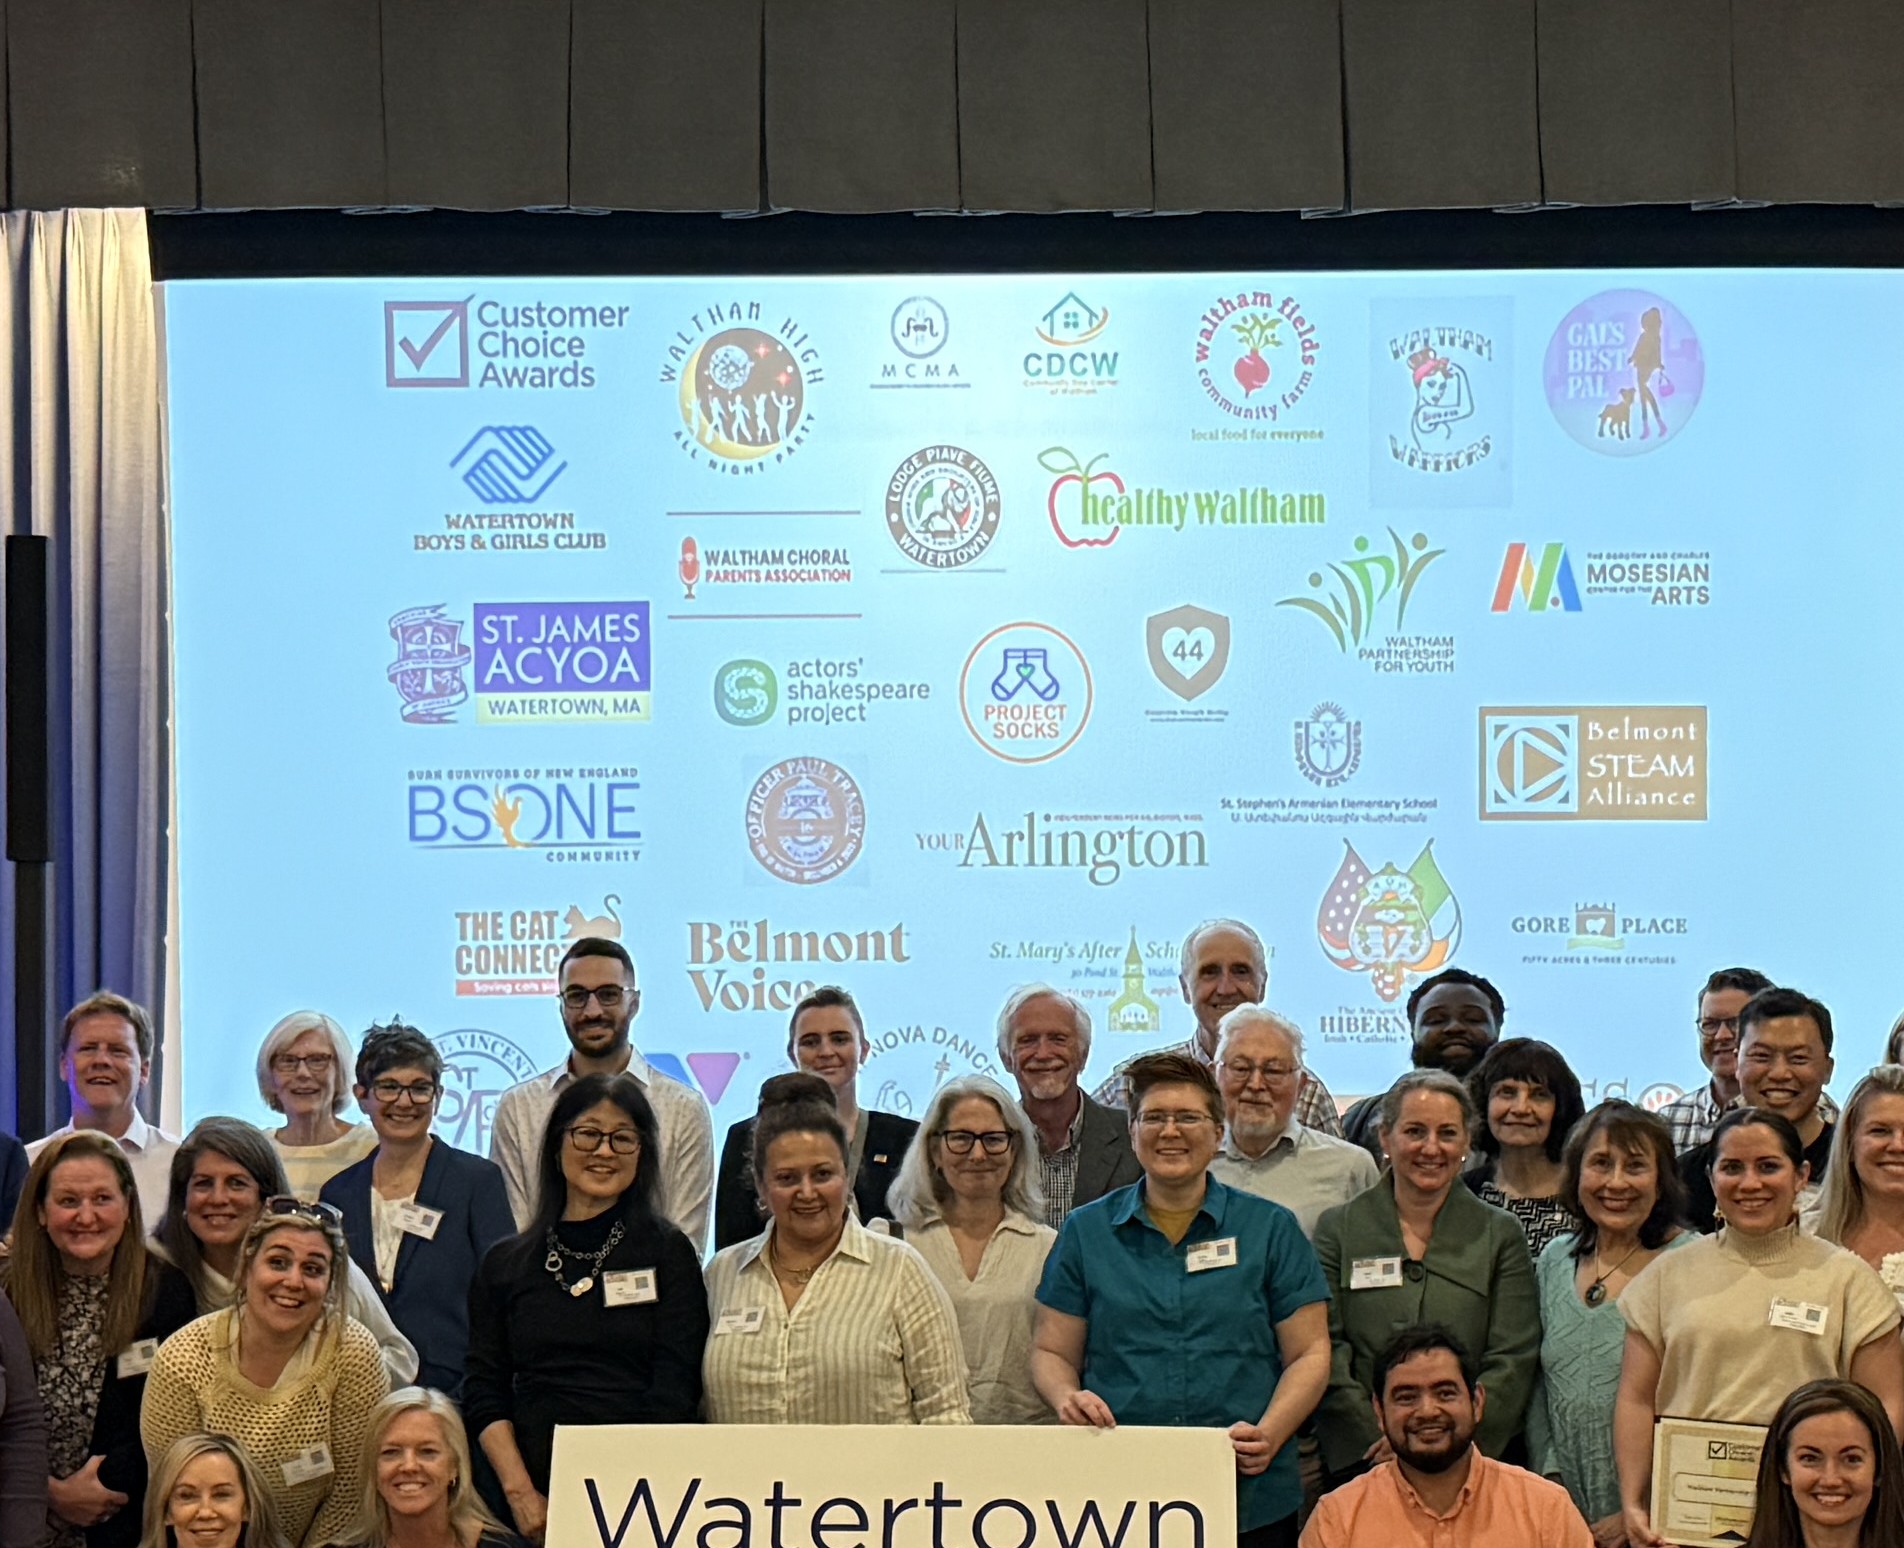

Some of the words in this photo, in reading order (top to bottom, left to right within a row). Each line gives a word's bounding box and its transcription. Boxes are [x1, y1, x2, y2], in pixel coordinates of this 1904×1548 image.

[477, 300, 630, 328] Customer
[1196, 291, 1272, 363] waltham
[477, 330, 585, 358] Choice
[659, 301, 761, 383] WALTHAM
[780, 317, 824, 384] HIGH
[1389, 327, 1492, 361] WALTHAM
[1023, 351, 1119, 377] CDCW
[1568, 349, 1627, 374] BEST
[478, 360, 596, 388] Awards
[1198, 368, 1278, 421] community
[1281, 370, 1313, 409] farm
[1568, 375, 1610, 399] PAL
[1191, 428, 1219, 441] local
[1221, 428, 1248, 441] food
[1270, 429, 1324, 442] everyone
[708, 458, 764, 476] NIGHT
[888, 453, 923, 503] LODGE
[925, 447, 967, 465] PIAVE
[1081, 485, 1189, 531] healthy
[444, 512, 574, 530] WATERTOWN
[413, 534, 466, 551] BOYS
[470, 534, 487, 550] &
[491, 533, 549, 550] GIRLS
[554, 532, 607, 549] CLUB
[899, 531, 990, 567] WATERTOWN
[704, 549, 784, 566] WALTHAM
[787, 549, 851, 565] CHORAL
[705, 569, 762, 583] PARENTS
[764, 568, 851, 582] ASSOCIATION
[1586, 563, 1710, 584] MOSESIAN
[1651, 586, 1710, 605] ARTS
[482, 615, 523, 644] ST.
[532, 613, 641, 644] JAMES
[1172, 639, 1204, 662] 44
[1385, 635, 1454, 647] WALTHAM
[483, 646, 641, 685] ACYOA
[1358, 648, 1454, 660] PARTNERSHIP
[1374, 660, 1405, 672] FOR
[1407, 660, 1454, 672] YOUTH
[787, 657, 864, 678] actors'
[787, 680, 930, 703] shakespeare
[488, 698, 608, 716] WATERTOWN,
[613, 698, 641, 714] MA
[788, 703, 866, 726] project
[984, 703, 1067, 722] PROJECT
[993, 722, 1059, 739] SOCKS
[1588, 715, 1697, 741] Belmont
[524, 769, 541, 779] OF
[1587, 754, 1695, 778] STEAM
[747, 767, 785, 839] OFFICER
[786, 759, 828, 775] PAUL
[833, 770, 863, 838] TRACEY
[1288, 798, 1339, 809] Armenian
[1340, 798, 1400, 811] Elementary
[1402, 798, 1438, 809] School
[1587, 781, 1696, 805] Alliance
[408, 782, 641, 843] BSONE
[546, 851, 641, 862] COMMUNITY
[915, 833, 965, 850] YOUR
[957, 811, 1210, 886] Arlington
[455, 911, 504, 941] THE
[510, 910, 559, 940] CAT
[1511, 916, 1570, 934] GORE
[1621, 917, 1688, 934] PLACE
[686, 918, 911, 965] Belmont
[989, 942, 1012, 959] St.
[1016, 941, 1076, 963] Mary's
[1078, 941, 1122, 961] After
[1145, 941, 1180, 959] Sch
[455, 943, 566, 976] CONNEC
[1320, 1016, 1407, 1034] HIBERN
[456, 1034, 533, 1079] VINCENT
